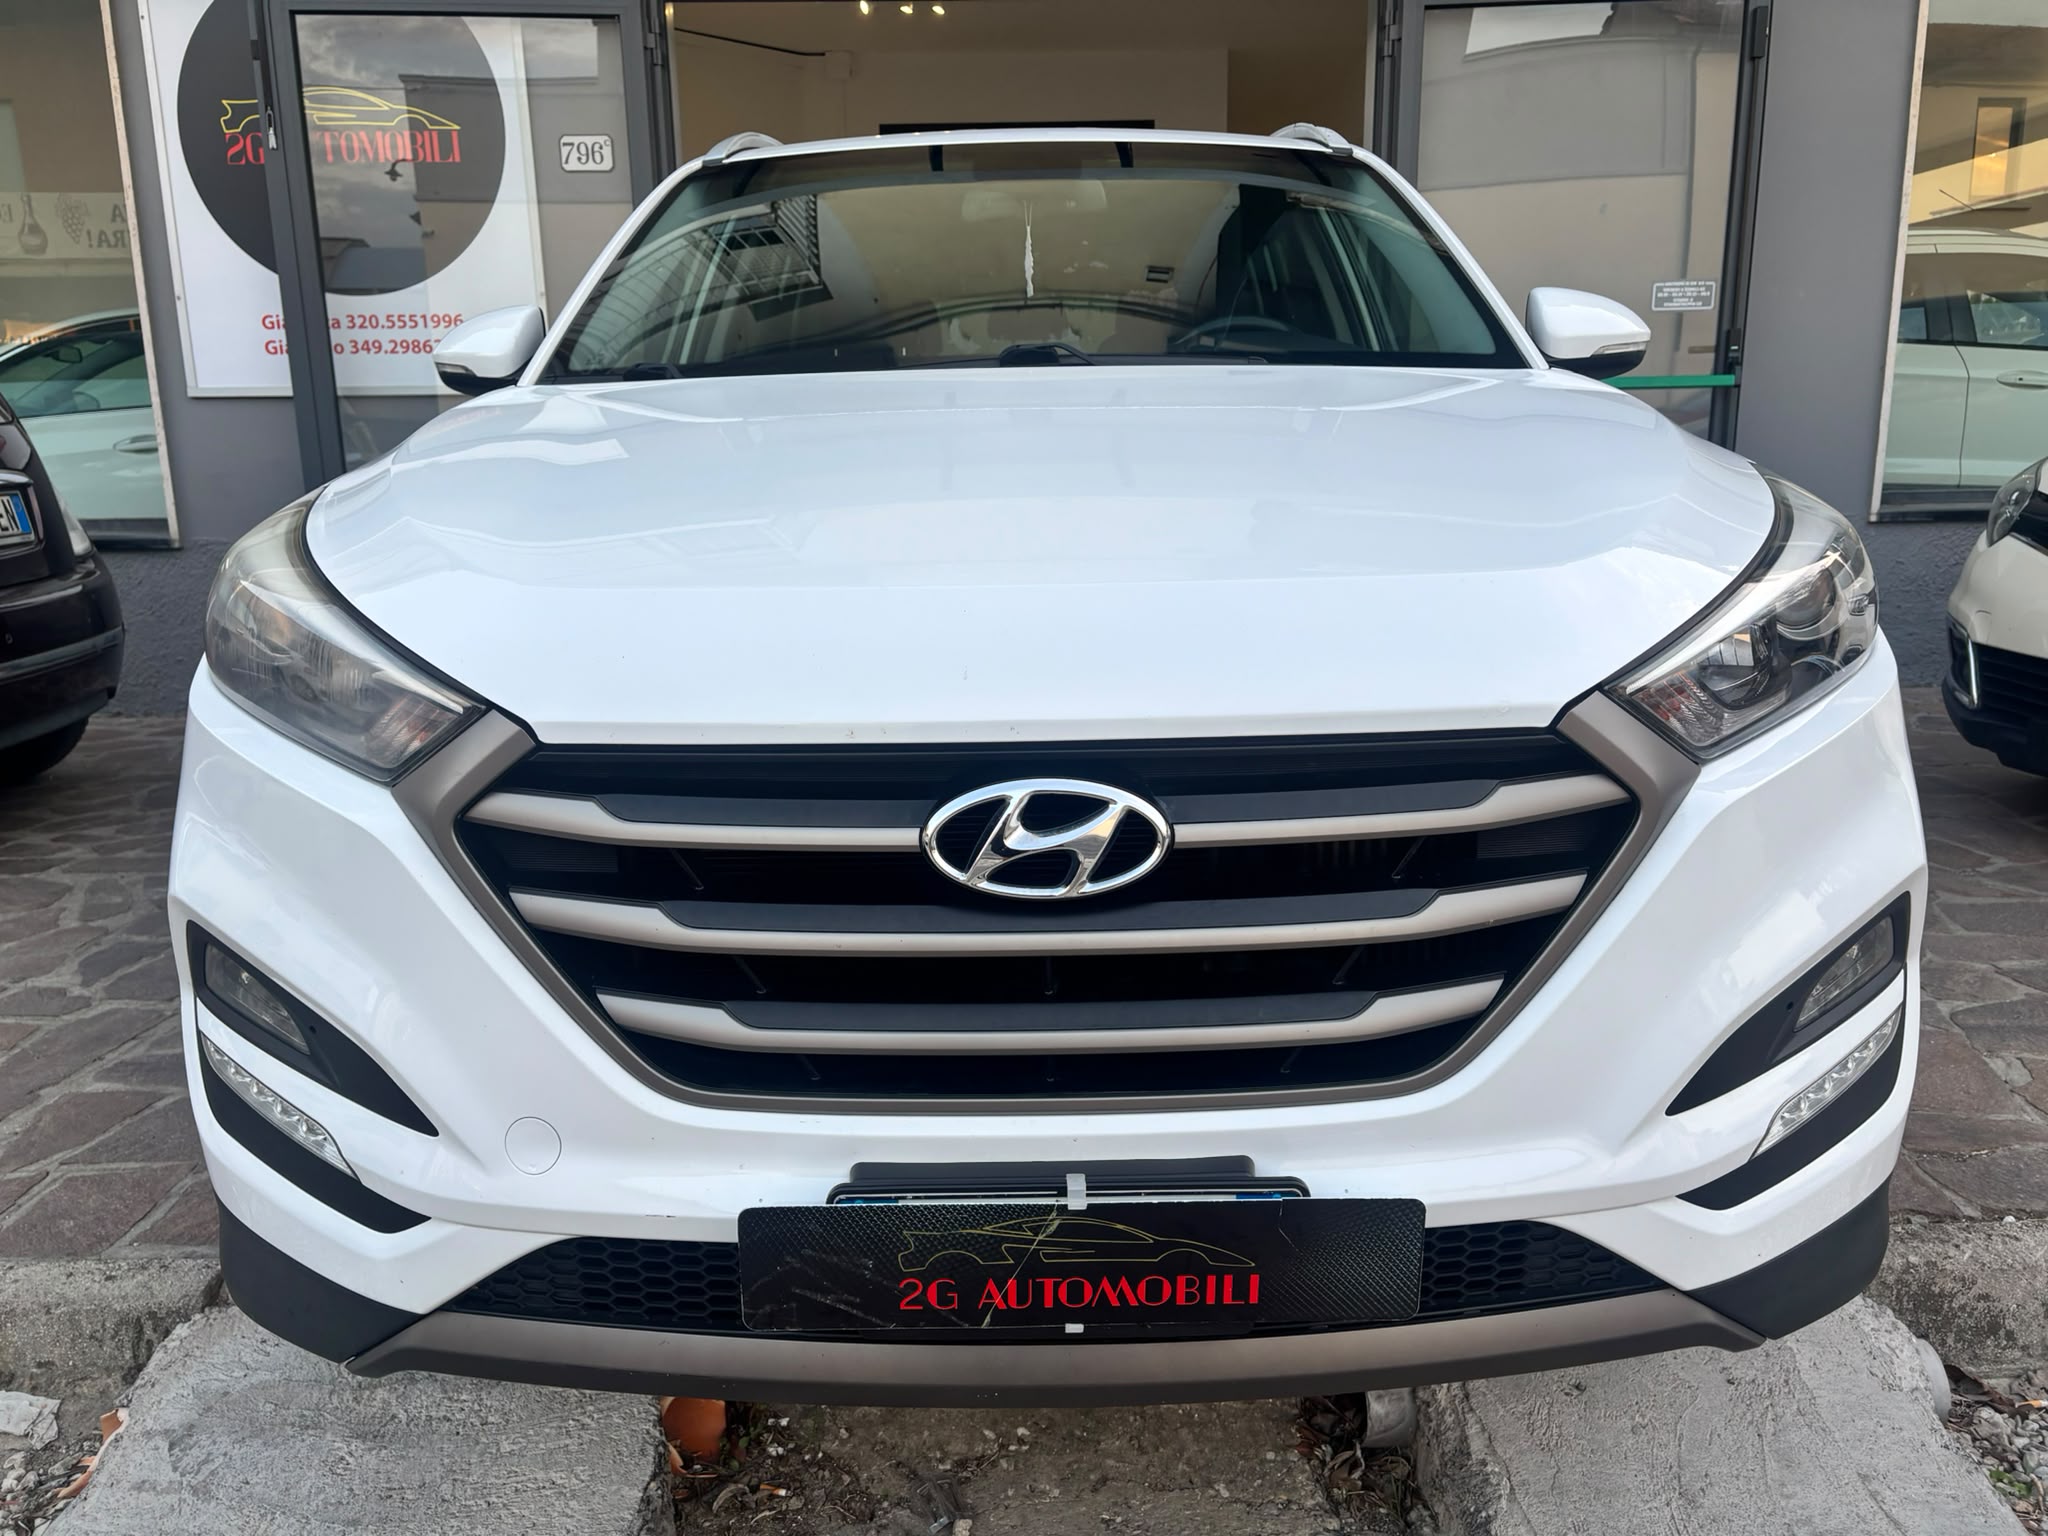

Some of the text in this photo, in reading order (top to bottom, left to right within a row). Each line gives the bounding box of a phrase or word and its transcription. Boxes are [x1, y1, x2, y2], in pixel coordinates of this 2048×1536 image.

[224, 128, 462, 165] 2G TOMOBILI
[346, 313, 464, 330] 320.5551996
[350, 339, 441, 355] 349.2986
[898, 1273, 1261, 1311] 2G AUTOMOBILI
